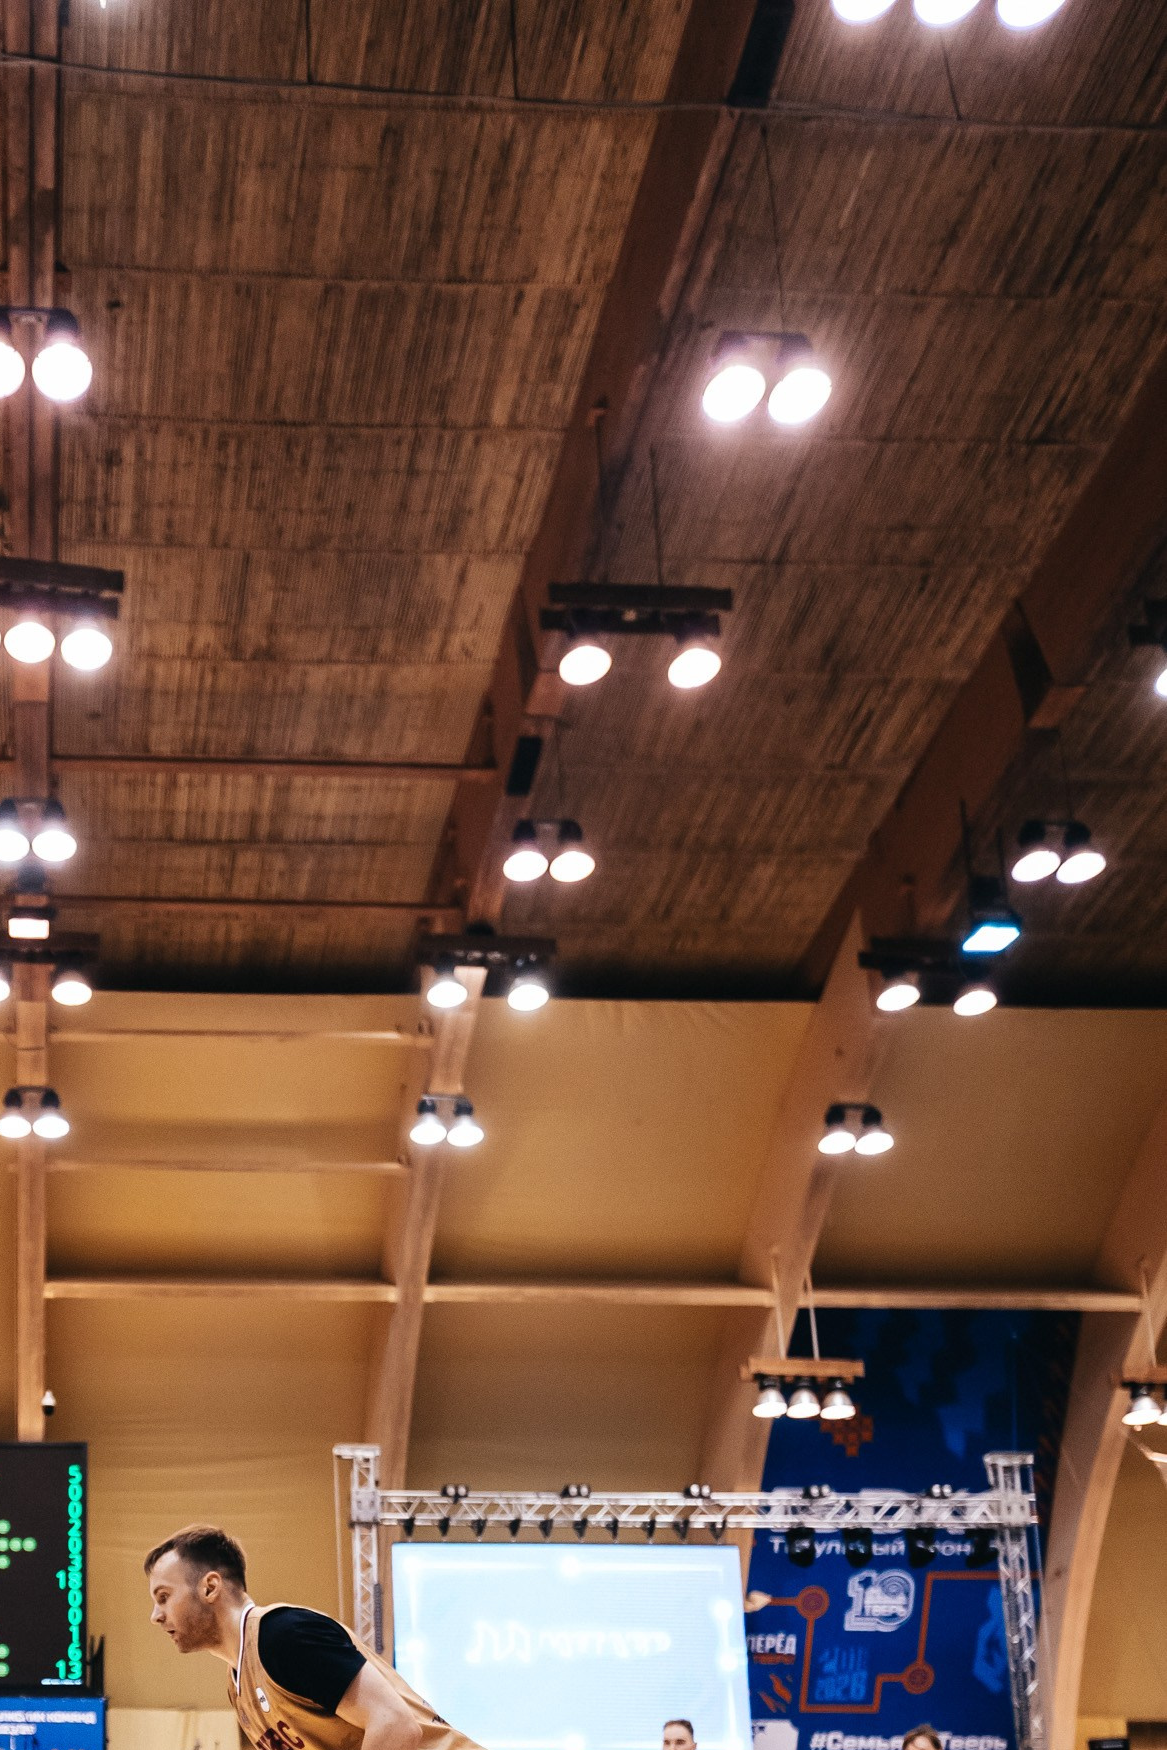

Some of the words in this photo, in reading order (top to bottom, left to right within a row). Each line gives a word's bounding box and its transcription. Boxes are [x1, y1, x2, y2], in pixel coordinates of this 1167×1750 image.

[68, 1465, 82, 1484] 5
[68, 1482, 82, 1501] 0
[68, 1500, 82, 1519] 0
[68, 1517, 82, 1536] 2
[68, 1535, 82, 1554] 0
[68, 1553, 82, 1572] 3
[56, 1571, 82, 1590] 18
[68, 1589, 82, 1608] 0
[68, 1607, 82, 1626] 0
[68, 1624, 81, 1643] 1
[68, 1642, 82, 1661] 6
[55, 1661, 82, 1680] 13
